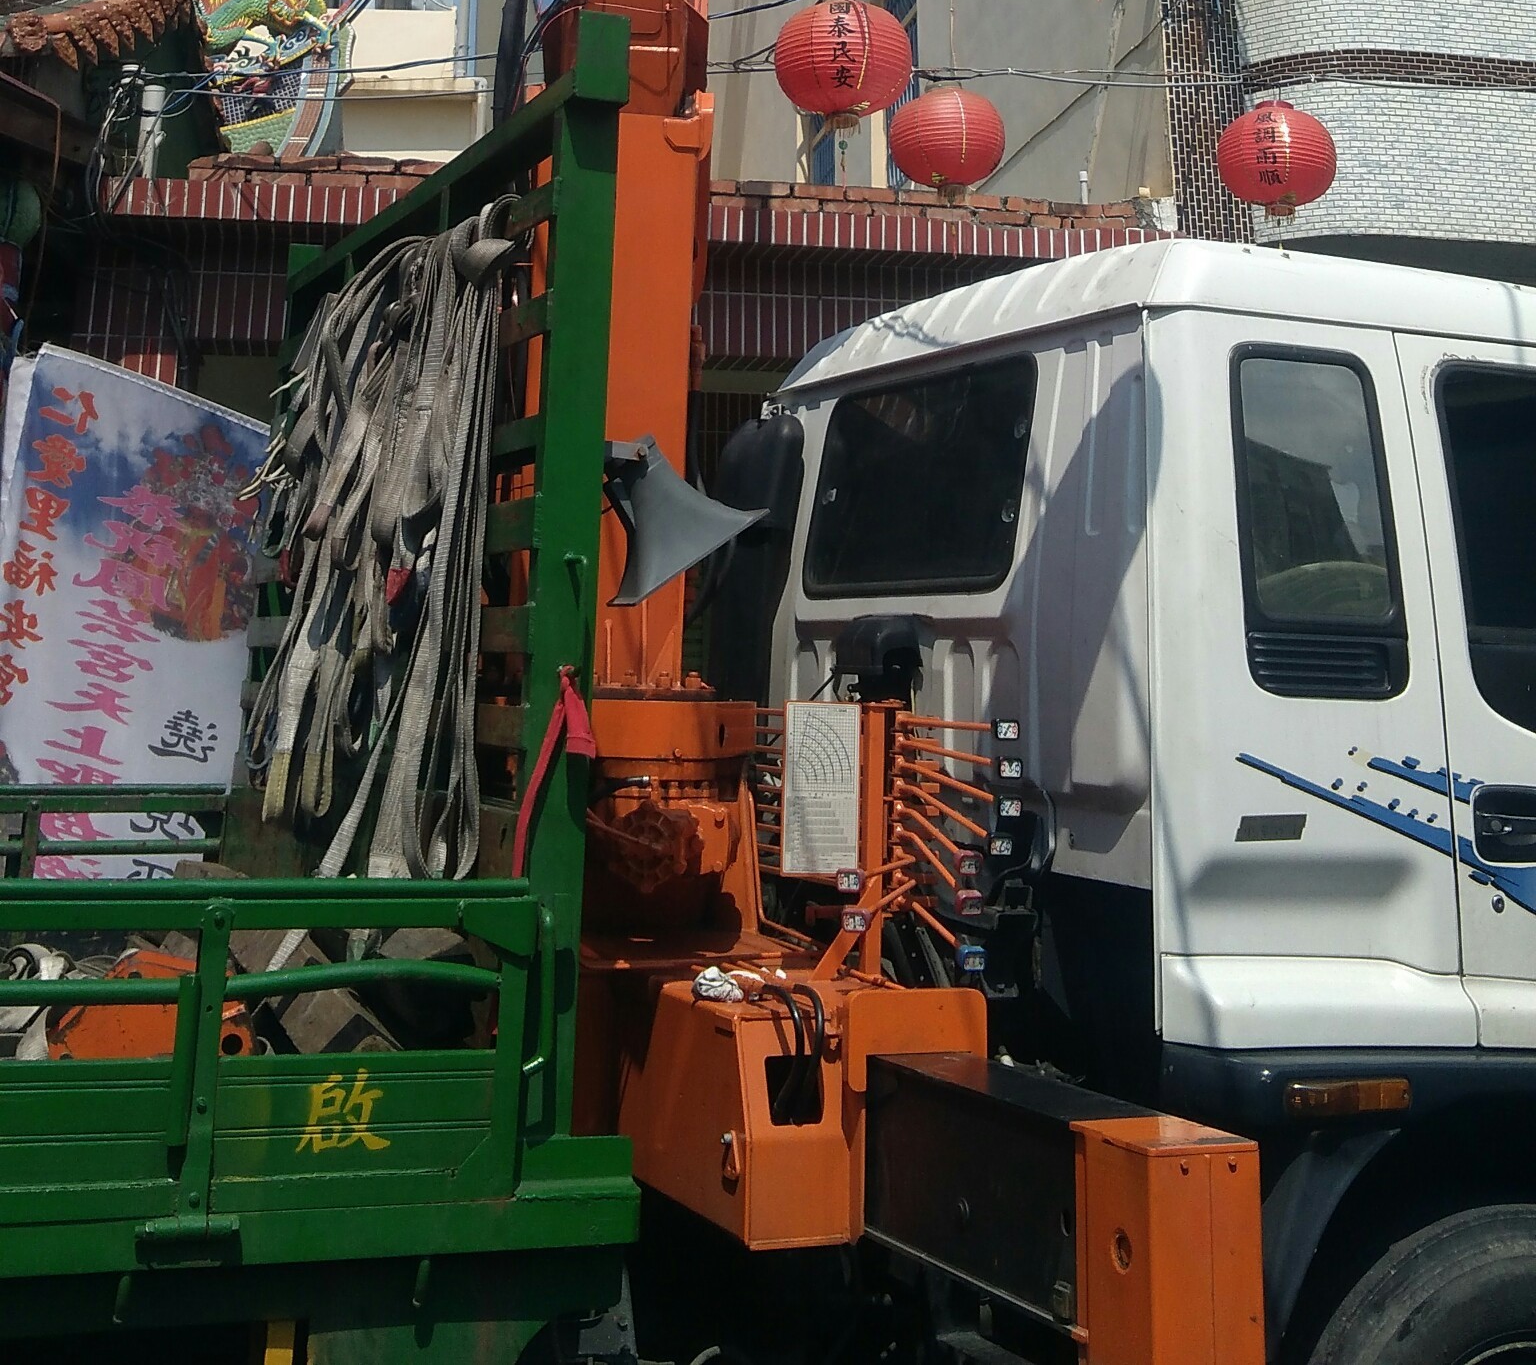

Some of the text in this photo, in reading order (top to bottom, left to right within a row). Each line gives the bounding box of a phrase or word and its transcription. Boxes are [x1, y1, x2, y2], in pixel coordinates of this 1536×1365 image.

[827, 1, 857, 88] 國泰民安
[1254, 111, 1284, 186] 風調雨順
